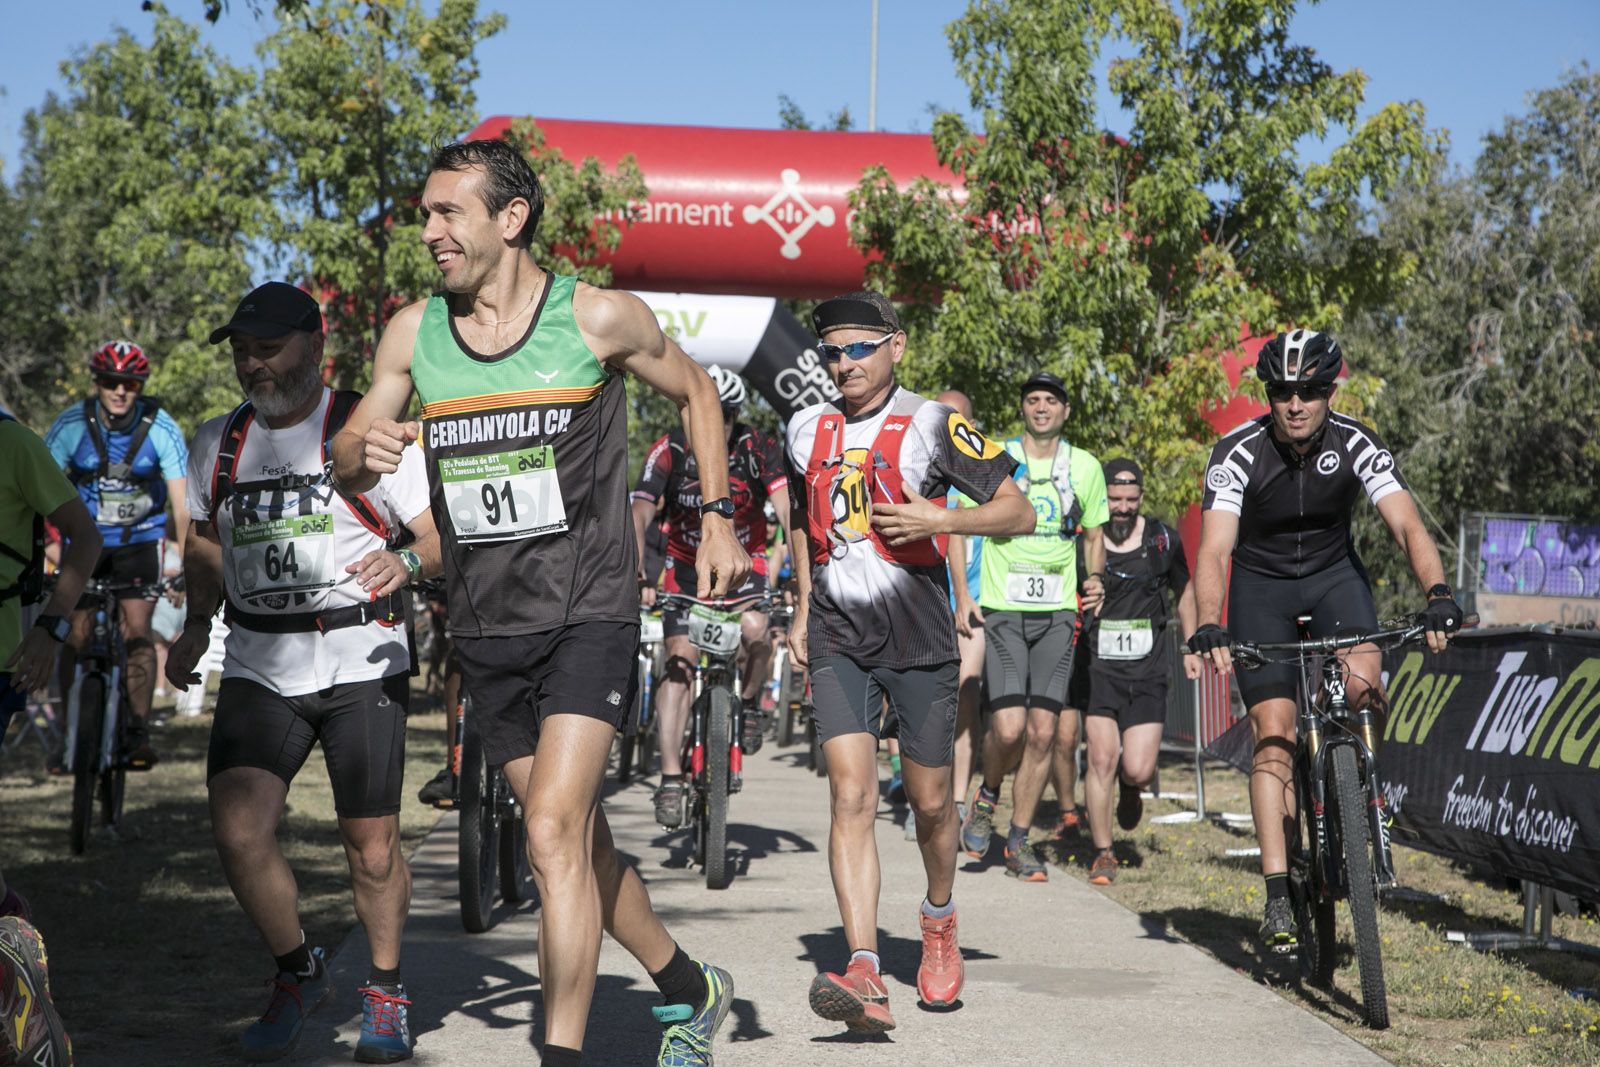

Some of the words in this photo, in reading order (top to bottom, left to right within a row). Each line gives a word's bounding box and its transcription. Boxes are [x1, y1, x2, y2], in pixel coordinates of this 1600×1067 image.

[430, 411, 540, 449] CERDANYOLA
[117, 503, 135, 519] 62
[481, 480, 518, 526] 91
[265, 541, 299, 582] 64
[1026, 577, 1044, 597] 33
[703, 623, 722, 646] 52
[1116, 633, 1131, 651] 11
[1442, 774, 1493, 833] freedom
[1494, 779, 1514, 835] to
[1515, 783, 1579, 853] discover
